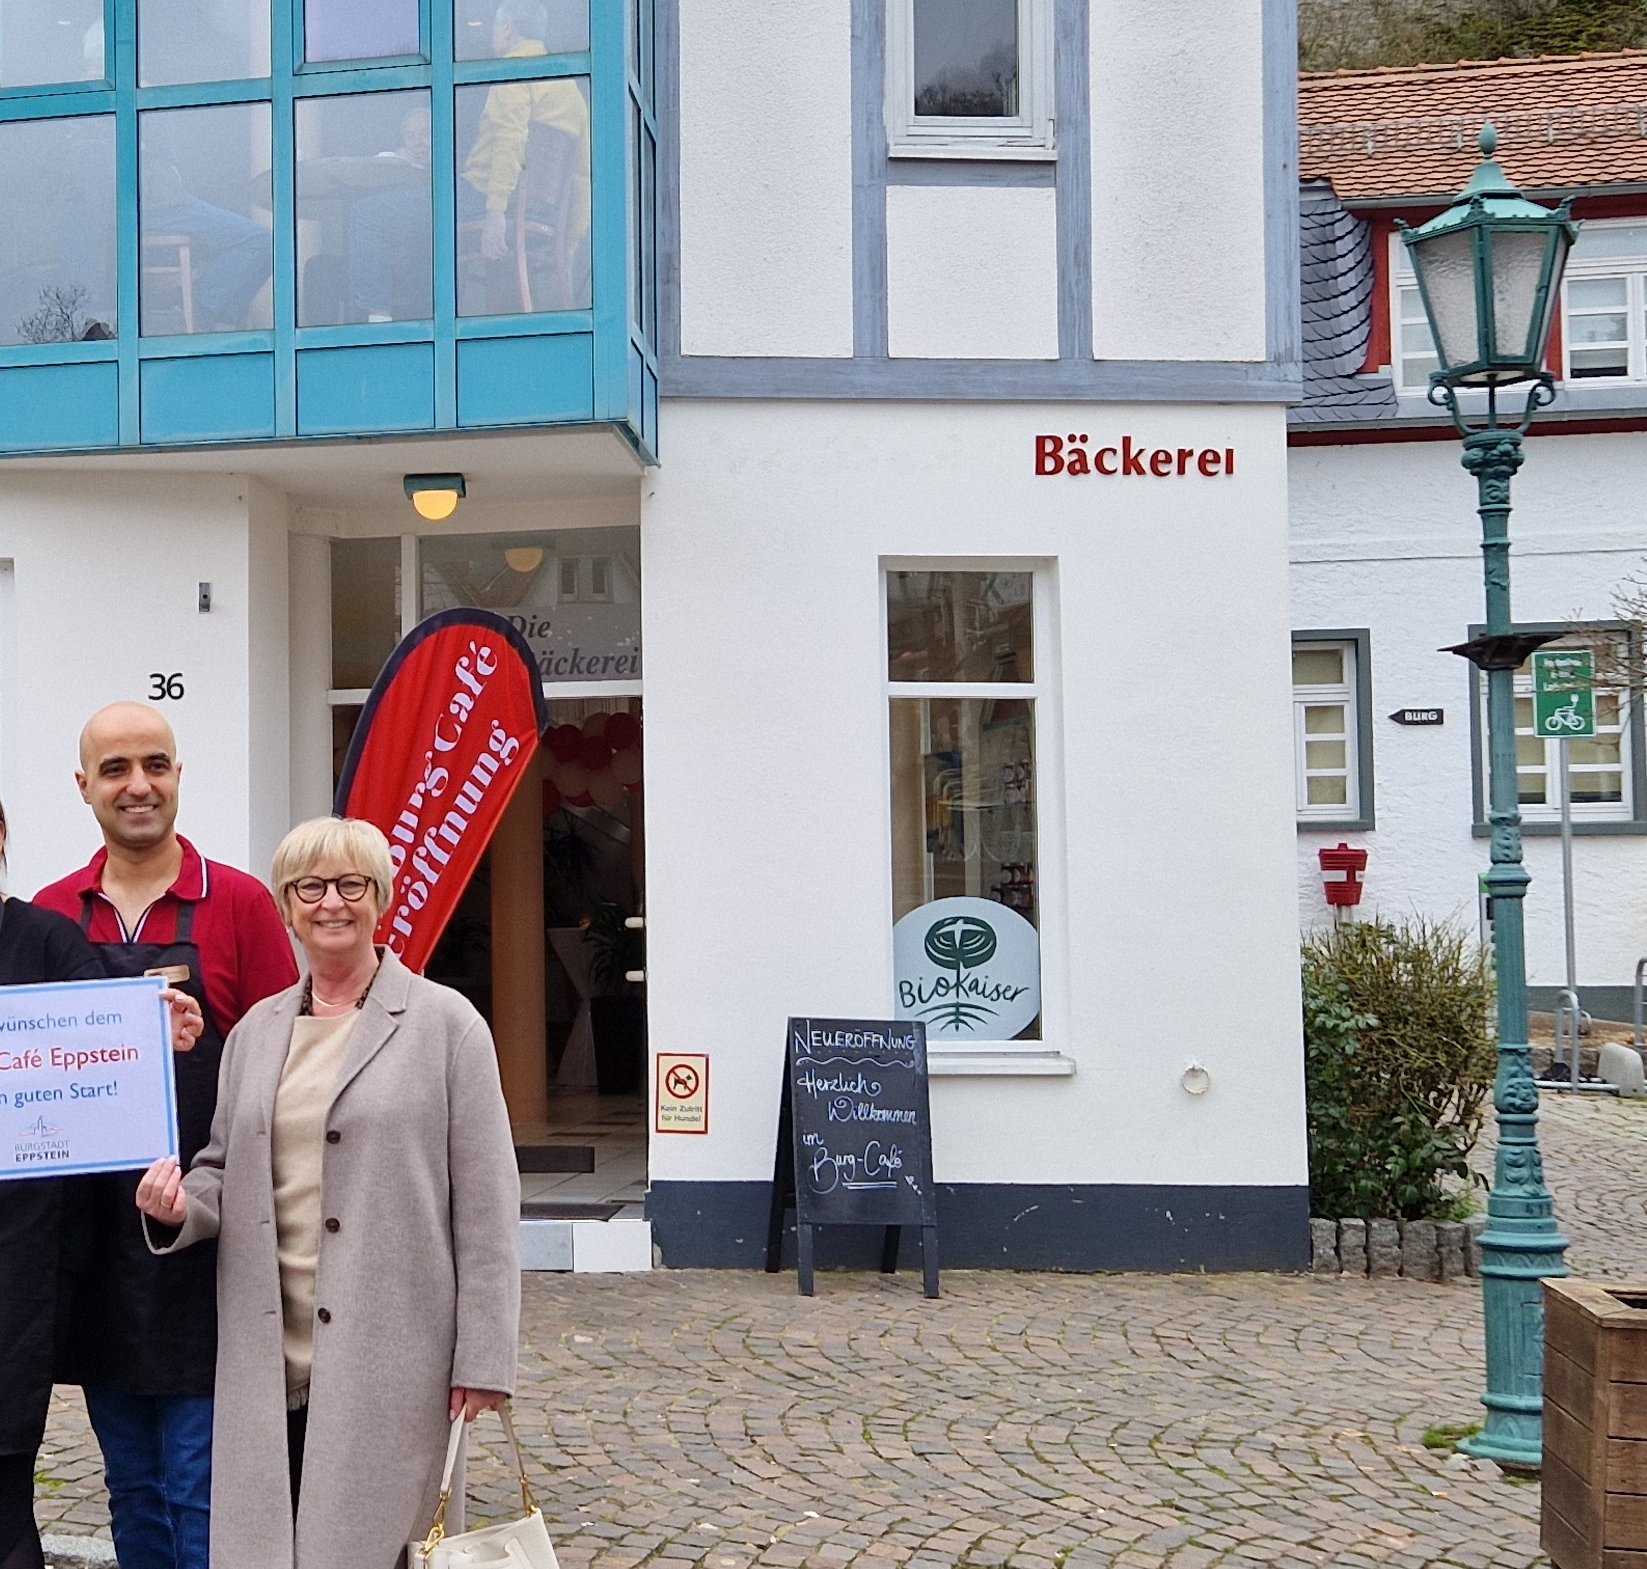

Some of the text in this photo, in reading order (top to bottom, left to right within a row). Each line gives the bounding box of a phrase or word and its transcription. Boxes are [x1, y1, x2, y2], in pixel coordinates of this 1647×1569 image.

[1035, 433, 1235, 478] Bäckerei
[538, 646, 640, 676] äckerei
[147, 672, 185, 701] 36
[433, 640, 498, 752] Café
[1404, 710, 1439, 722] BURG
[84, 1010, 123, 1026] dem
[51, 1045, 139, 1072] Eppstein
[13, 1087, 64, 1109] guten
[69, 1080, 119, 1100] Start!
[796, 1068, 882, 1100] Herzlich
[827, 1095, 918, 1126] Willkommen
[14, 1139, 70, 1152] BURGSTADT
[801, 1129, 825, 1146] im
[15, 1149, 70, 1163] EPPSTEIN
[807, 1140, 903, 1195] Burg-Café
